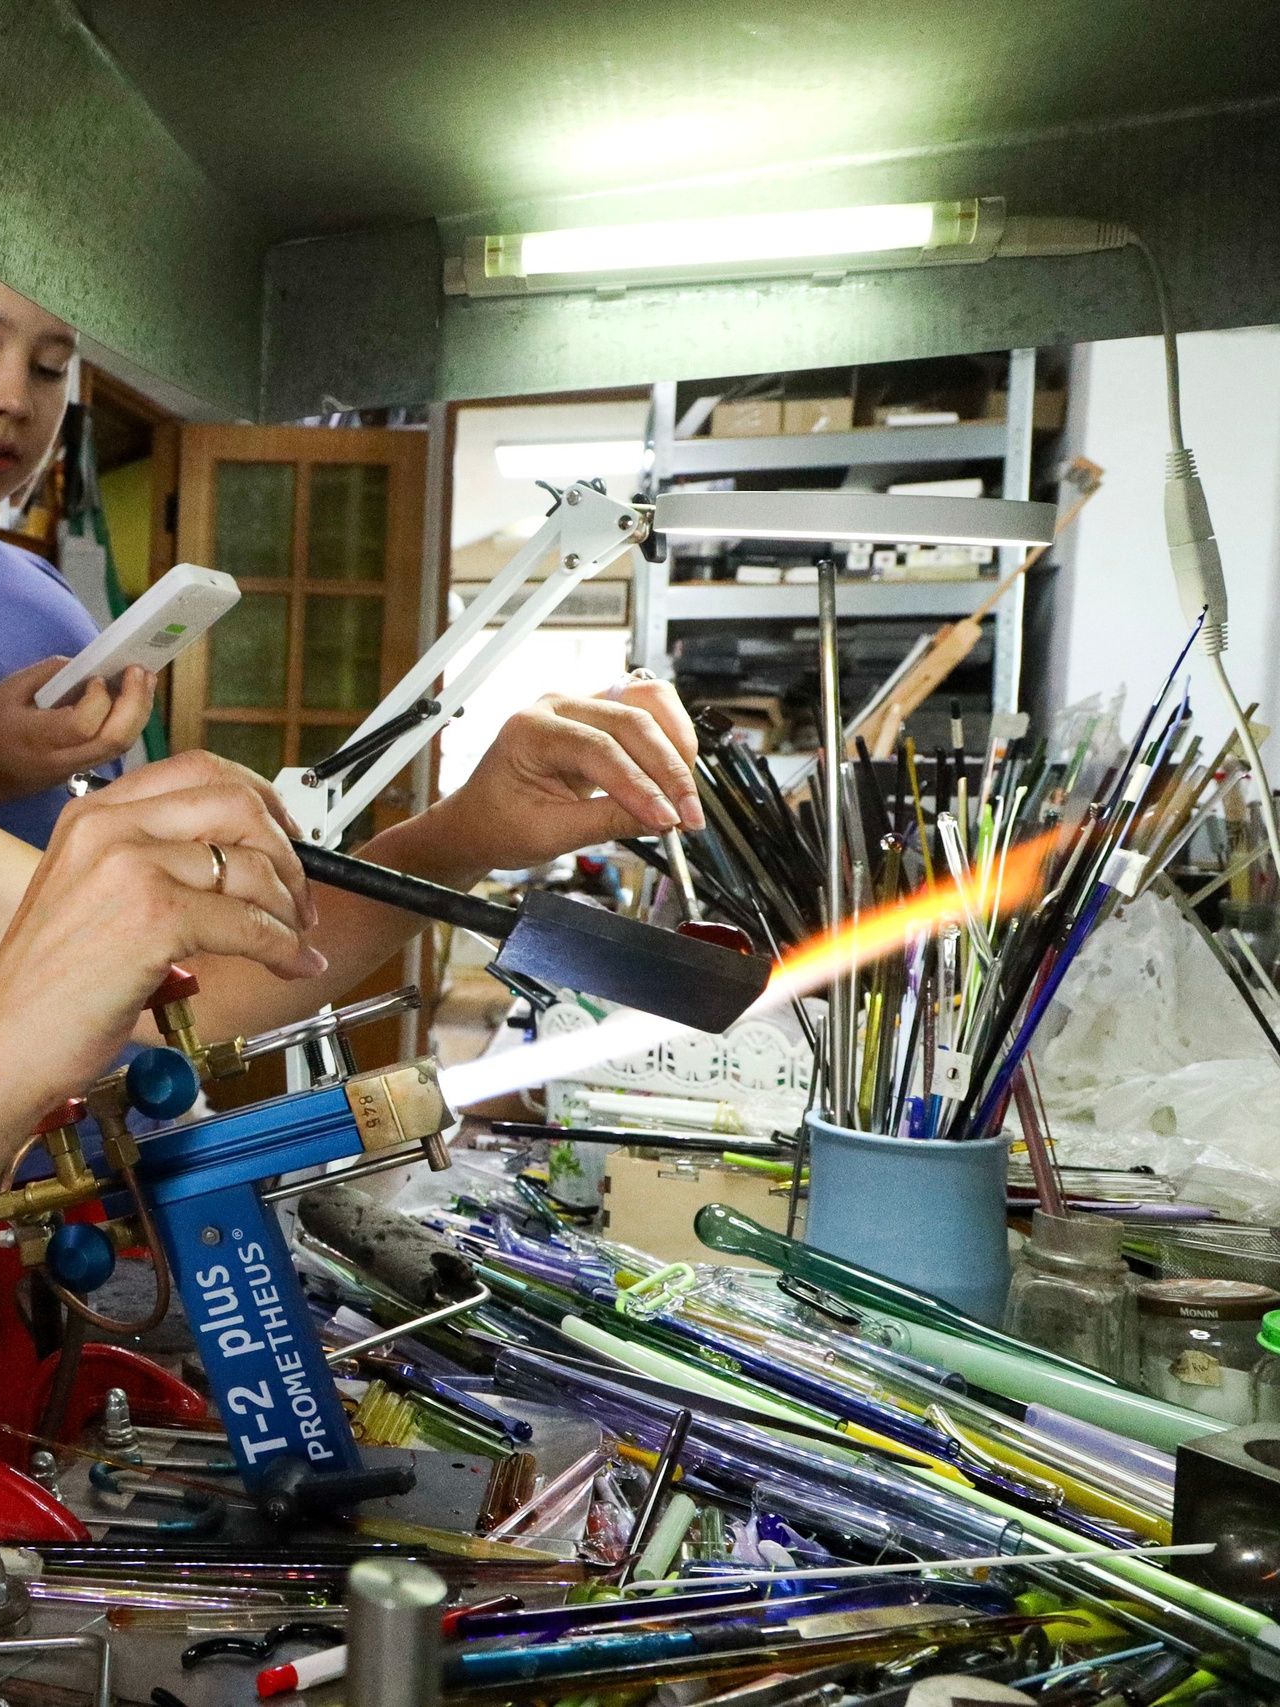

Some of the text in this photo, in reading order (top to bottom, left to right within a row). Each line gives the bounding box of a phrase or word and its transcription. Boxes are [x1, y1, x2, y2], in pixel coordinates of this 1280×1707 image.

[196, 1265, 288, 1464] T-2 plus
[1180, 1307, 1219, 1318] MONINI
